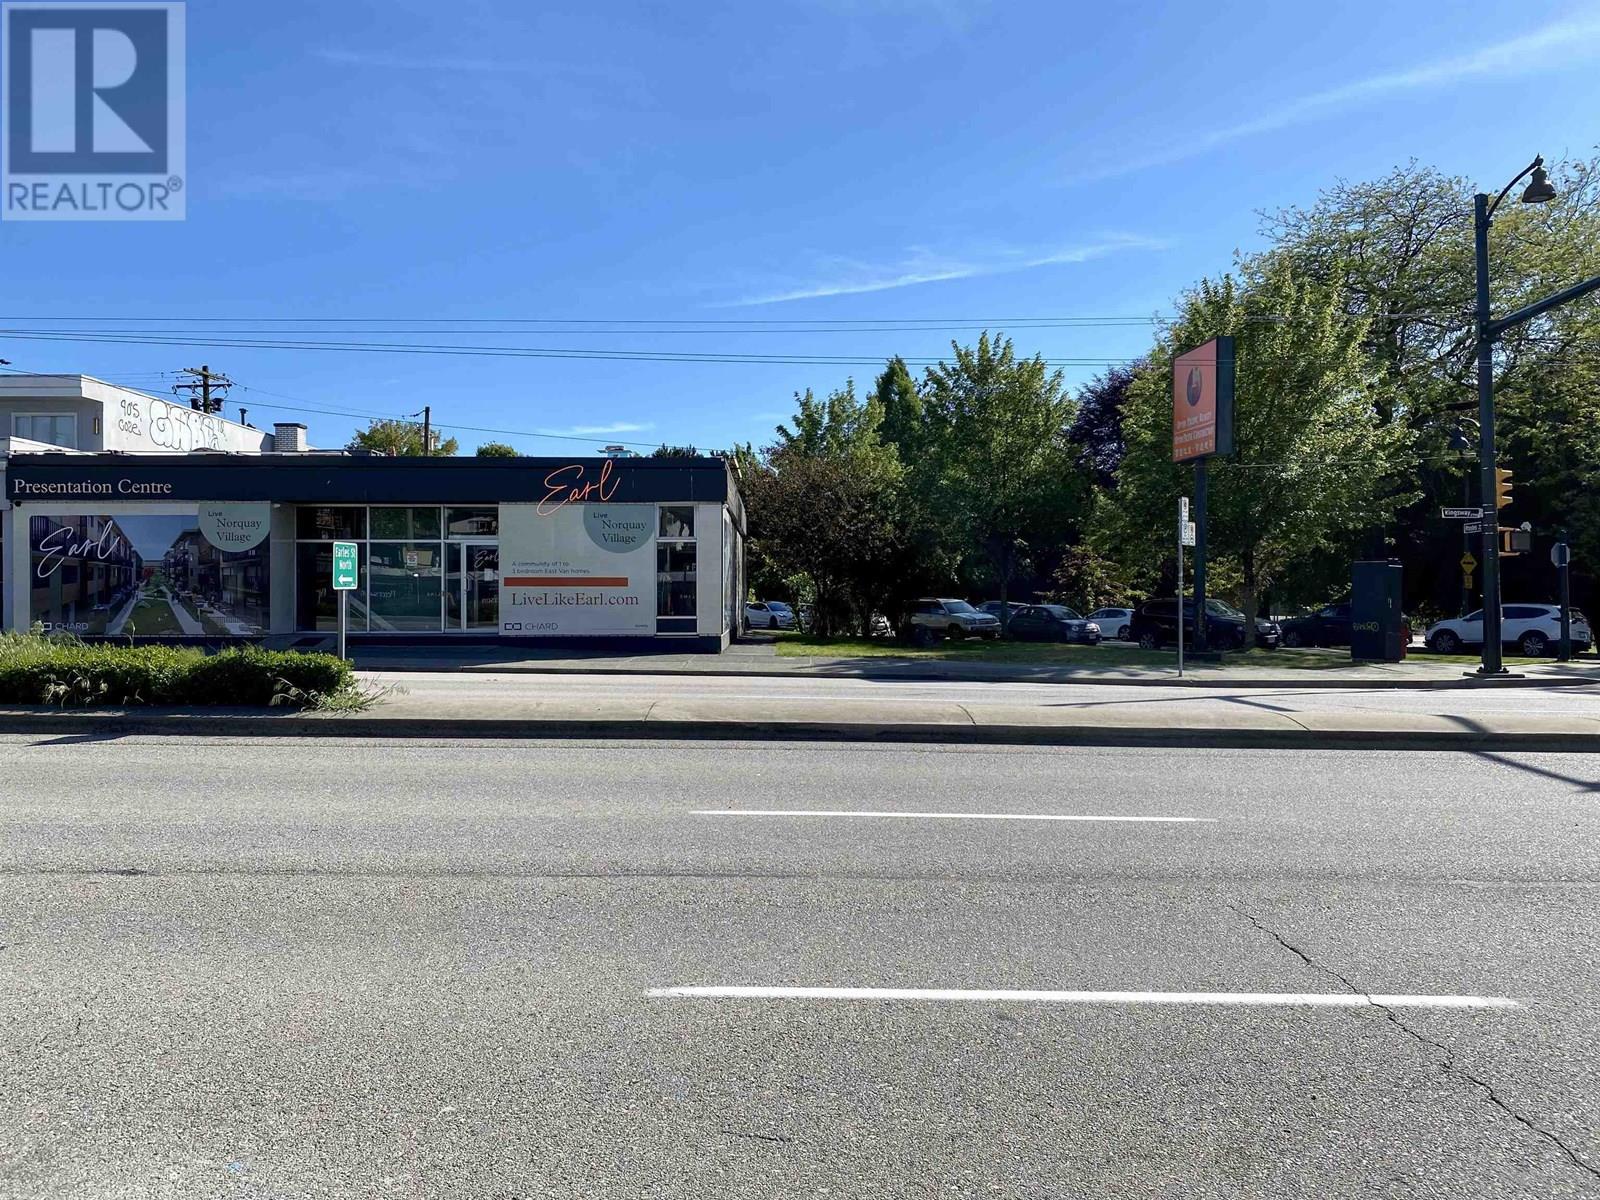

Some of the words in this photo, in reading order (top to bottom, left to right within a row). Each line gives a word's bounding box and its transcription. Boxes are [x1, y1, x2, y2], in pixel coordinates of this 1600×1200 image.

[14, 479, 113, 494] Presentation
[118, 479, 172, 494] Centre
[536, 459, 621, 516] Earl
[1444, 509, 1471, 517] Kingsway
[216, 518, 262, 532] Norquay
[601, 518, 647, 532] Norquay
[216, 531, 252, 544] Village
[601, 532, 637, 545] Village
[37, 520, 121, 578] Earl
[511, 592, 639, 606] LiveLikeEarl.com
[525, 622, 559, 631] CHARD
